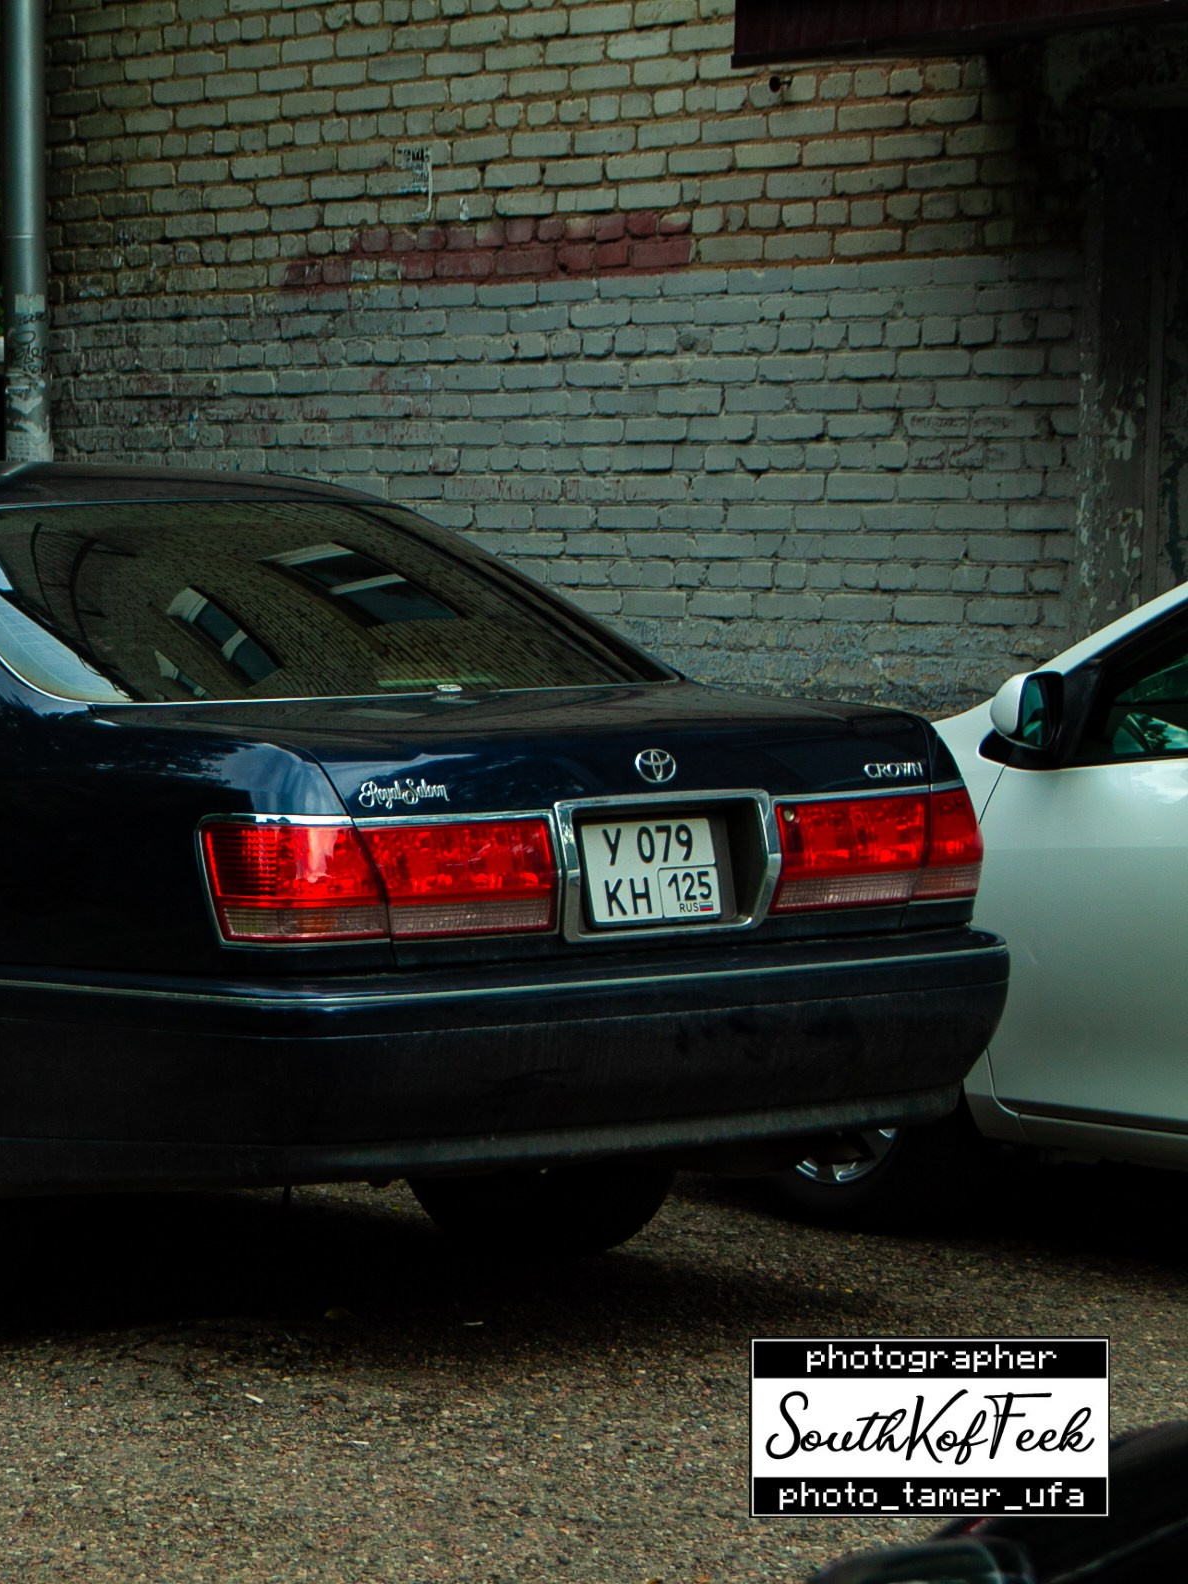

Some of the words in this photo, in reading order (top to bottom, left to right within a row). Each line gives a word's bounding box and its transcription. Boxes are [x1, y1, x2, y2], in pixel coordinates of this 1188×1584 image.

[863, 761, 924, 778] CROWN
[358, 780, 402, 809] Royal
[401, 778, 450, 804] Saloon
[637, 823, 693, 864] 079
[667, 870, 712, 902] 125
[679, 902, 699, 912] RUS
